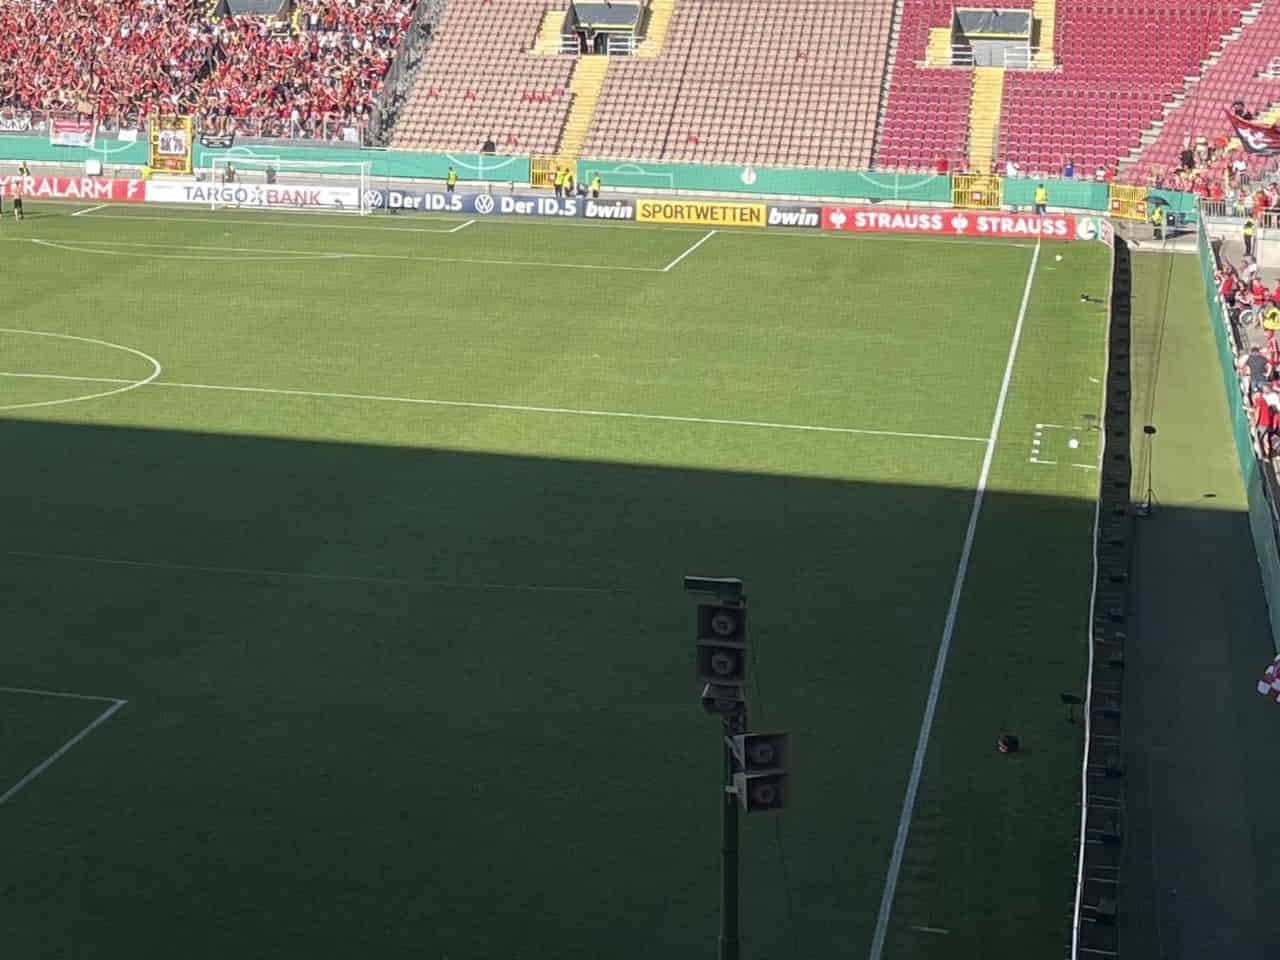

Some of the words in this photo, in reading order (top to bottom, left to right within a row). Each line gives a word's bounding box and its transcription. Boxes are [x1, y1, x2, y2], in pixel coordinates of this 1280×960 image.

[389, 192, 422, 208] Der
[425, 193, 463, 211] ID.5
[500, 196, 535, 213] Der
[538, 197, 577, 216] ID.5
[585, 200, 633, 219] bwin
[641, 203, 761, 223] SPORTWETTEN
[768, 206, 819, 226] bwin
[854, 211, 943, 230] STRAUSS
[976, 216, 1068, 235] STRAUSS
